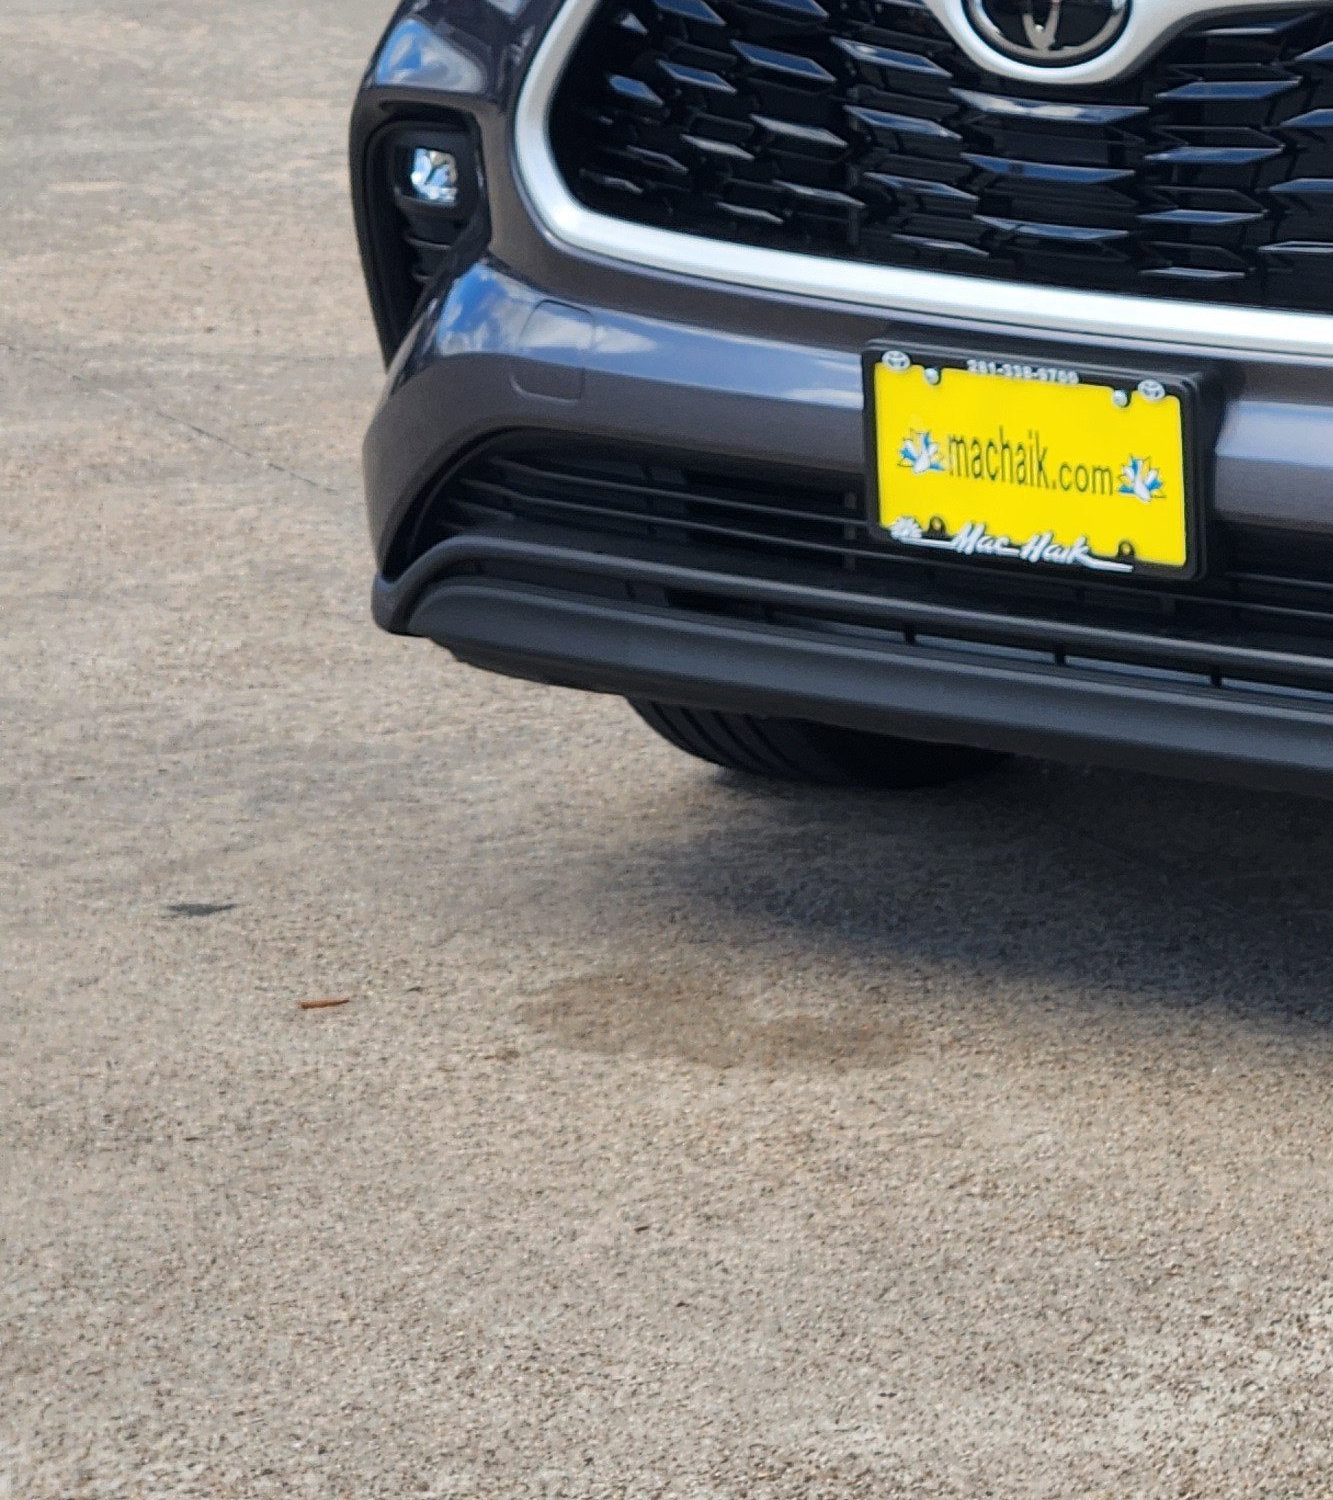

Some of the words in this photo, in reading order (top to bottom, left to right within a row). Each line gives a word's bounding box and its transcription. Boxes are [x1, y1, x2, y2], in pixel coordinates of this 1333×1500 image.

[949, 425, 1113, 496] machaik.com
[951, 521, 1020, 556] Mac
[1020, 530, 1112, 567] Haik
